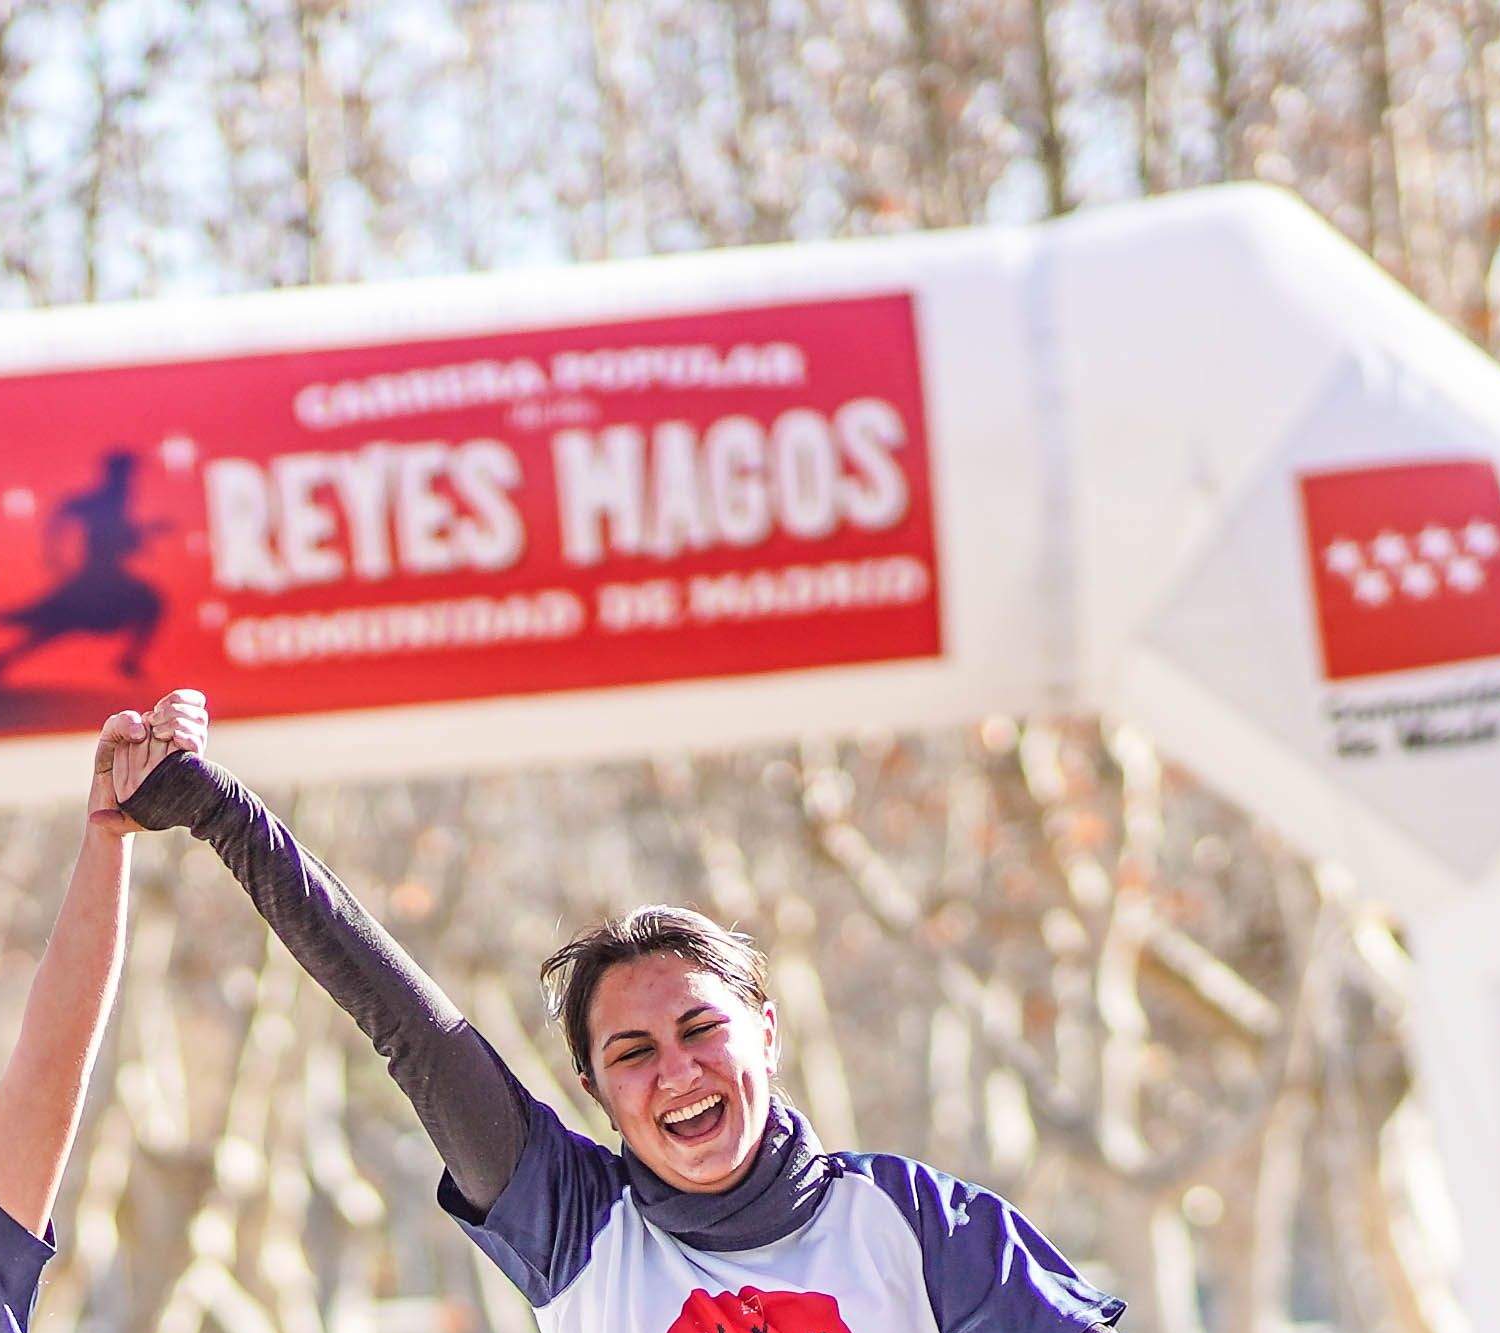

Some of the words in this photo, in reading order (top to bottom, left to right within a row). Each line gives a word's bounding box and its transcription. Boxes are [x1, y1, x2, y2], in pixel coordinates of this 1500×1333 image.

[204, 439, 526, 594] REYES
[553, 397, 908, 566] MAGOS
[597, 582, 681, 632] DE
[689, 556, 928, 622] MADRID
